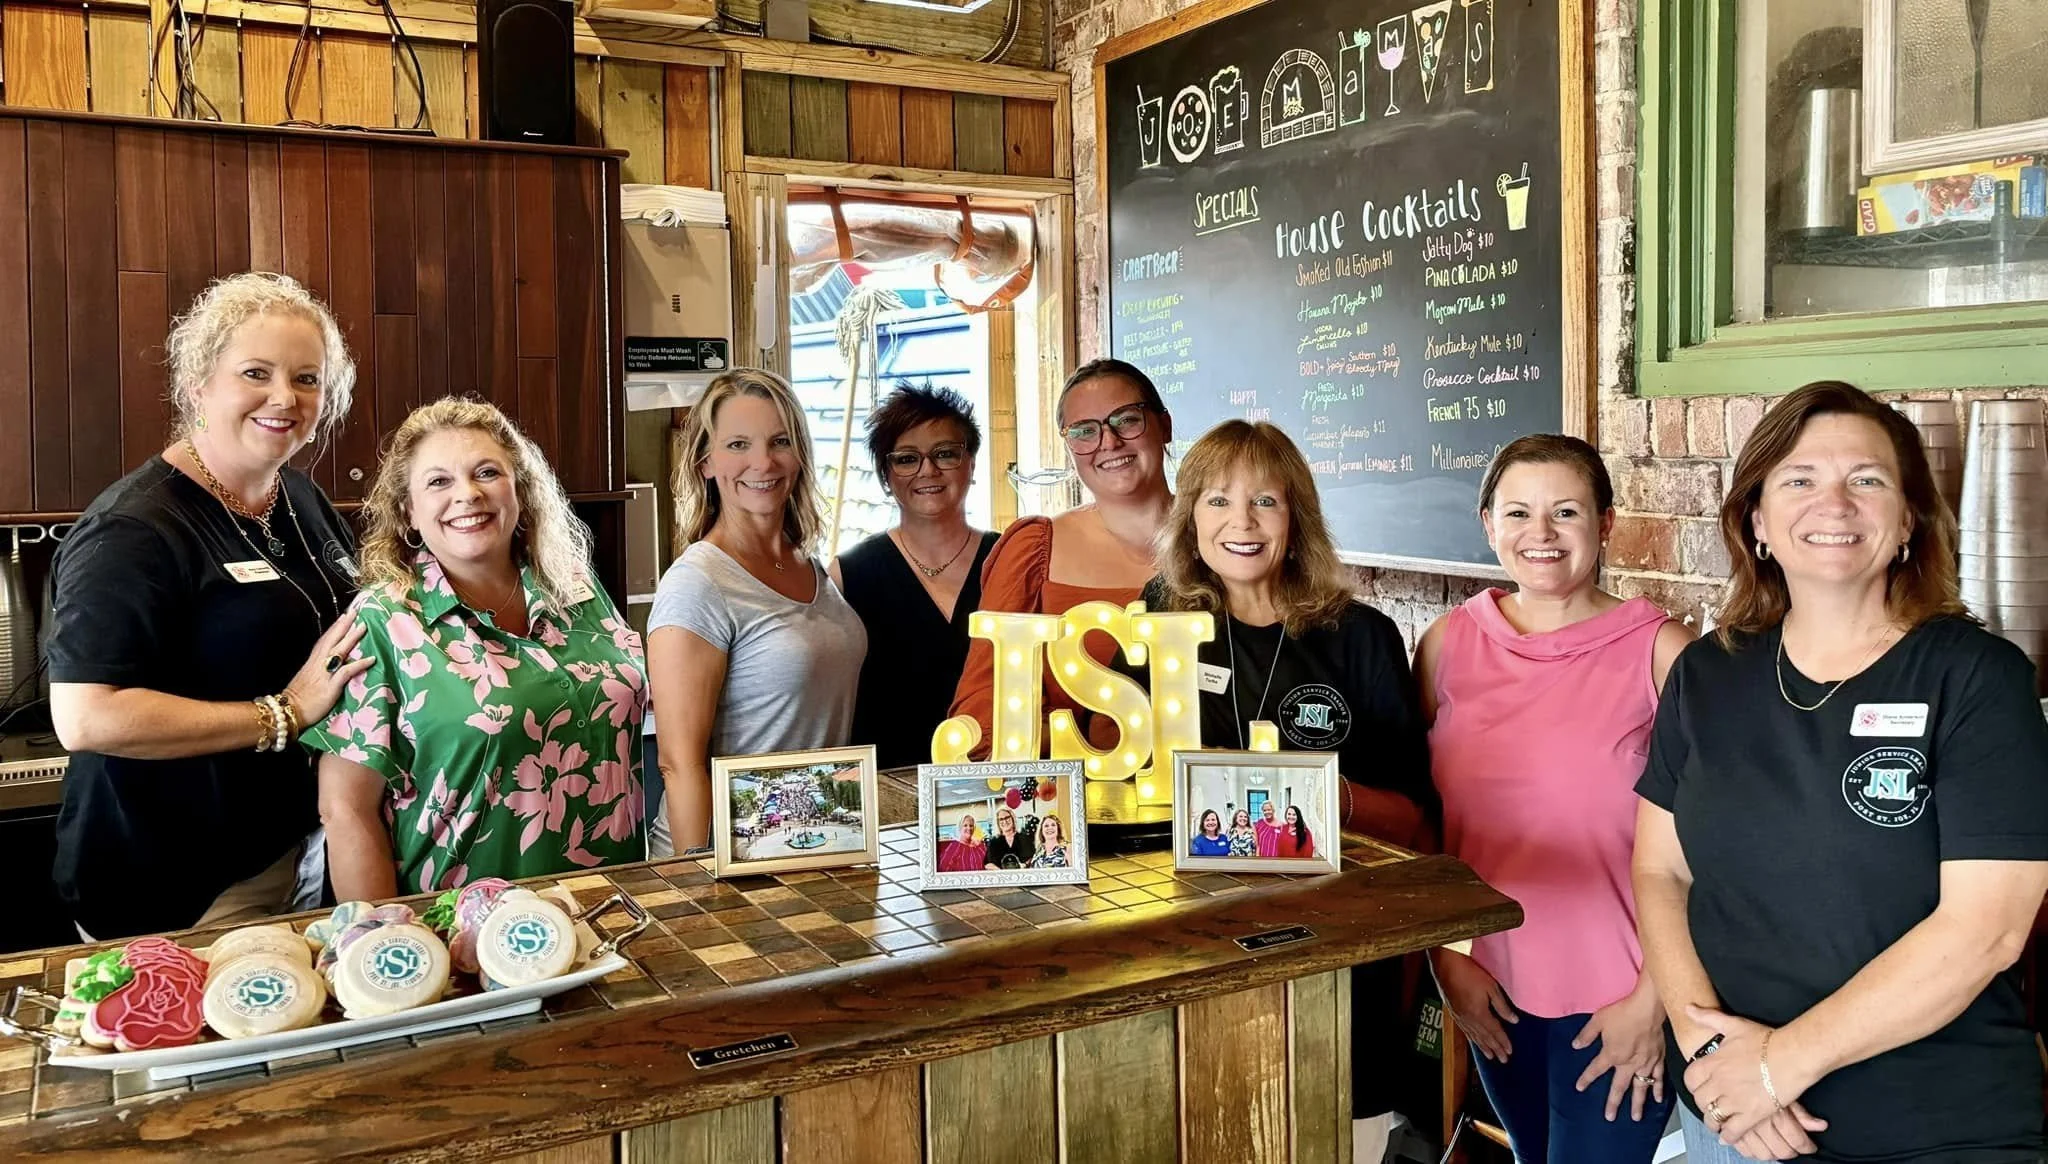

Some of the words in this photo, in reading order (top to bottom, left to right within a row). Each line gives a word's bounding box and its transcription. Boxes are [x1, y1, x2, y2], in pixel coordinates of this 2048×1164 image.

[1194, 185, 1259, 229] SPECIALS
[1863, 200, 1876, 233] GLAD
[1422, 235, 1452, 262] Salty
[1454, 231, 1473, 262] Dog
[1478, 232, 1494, 249] $10
[1123, 254, 1153, 282] CRAFT
[1335, 256, 1351, 278] Old
[1451, 262, 1496, 285] COLADA
[1501, 258, 1518, 278] $10
[1370, 284, 1383, 302] $10
[1457, 295, 1485, 314] Mule
[1491, 293, 1506, 309] $10
[1300, 361, 1319, 376] BOLD
[1382, 342, 1396, 356] $10
[1424, 333, 1478, 360] Kentucky
[1480, 335, 1501, 352] Mule
[1505, 333, 1523, 352] $10
[1423, 367, 1475, 389] Prosecco
[1478, 365, 1519, 384] Cocktail
[1523, 364, 1540, 381] $10
[1230, 390, 1257, 406] HAPPY
[1351, 384, 1364, 400] $10
[1427, 398, 1462, 422] FRENCH
[1463, 396, 1480, 420] 75
[1486, 398, 1506, 418] $10
[1295, 703, 1334, 731] JSL
[1850, 753, 1875, 774] JUNIOR
[1863, 767, 1916, 801] JSL
[1853, 801, 1875, 817] PORT
[508, 921, 548, 955] JSL
[376, 946, 418, 979] JSL
[239, 977, 285, 1007] JSL
[714, 1042, 777, 1059] Gretchen
